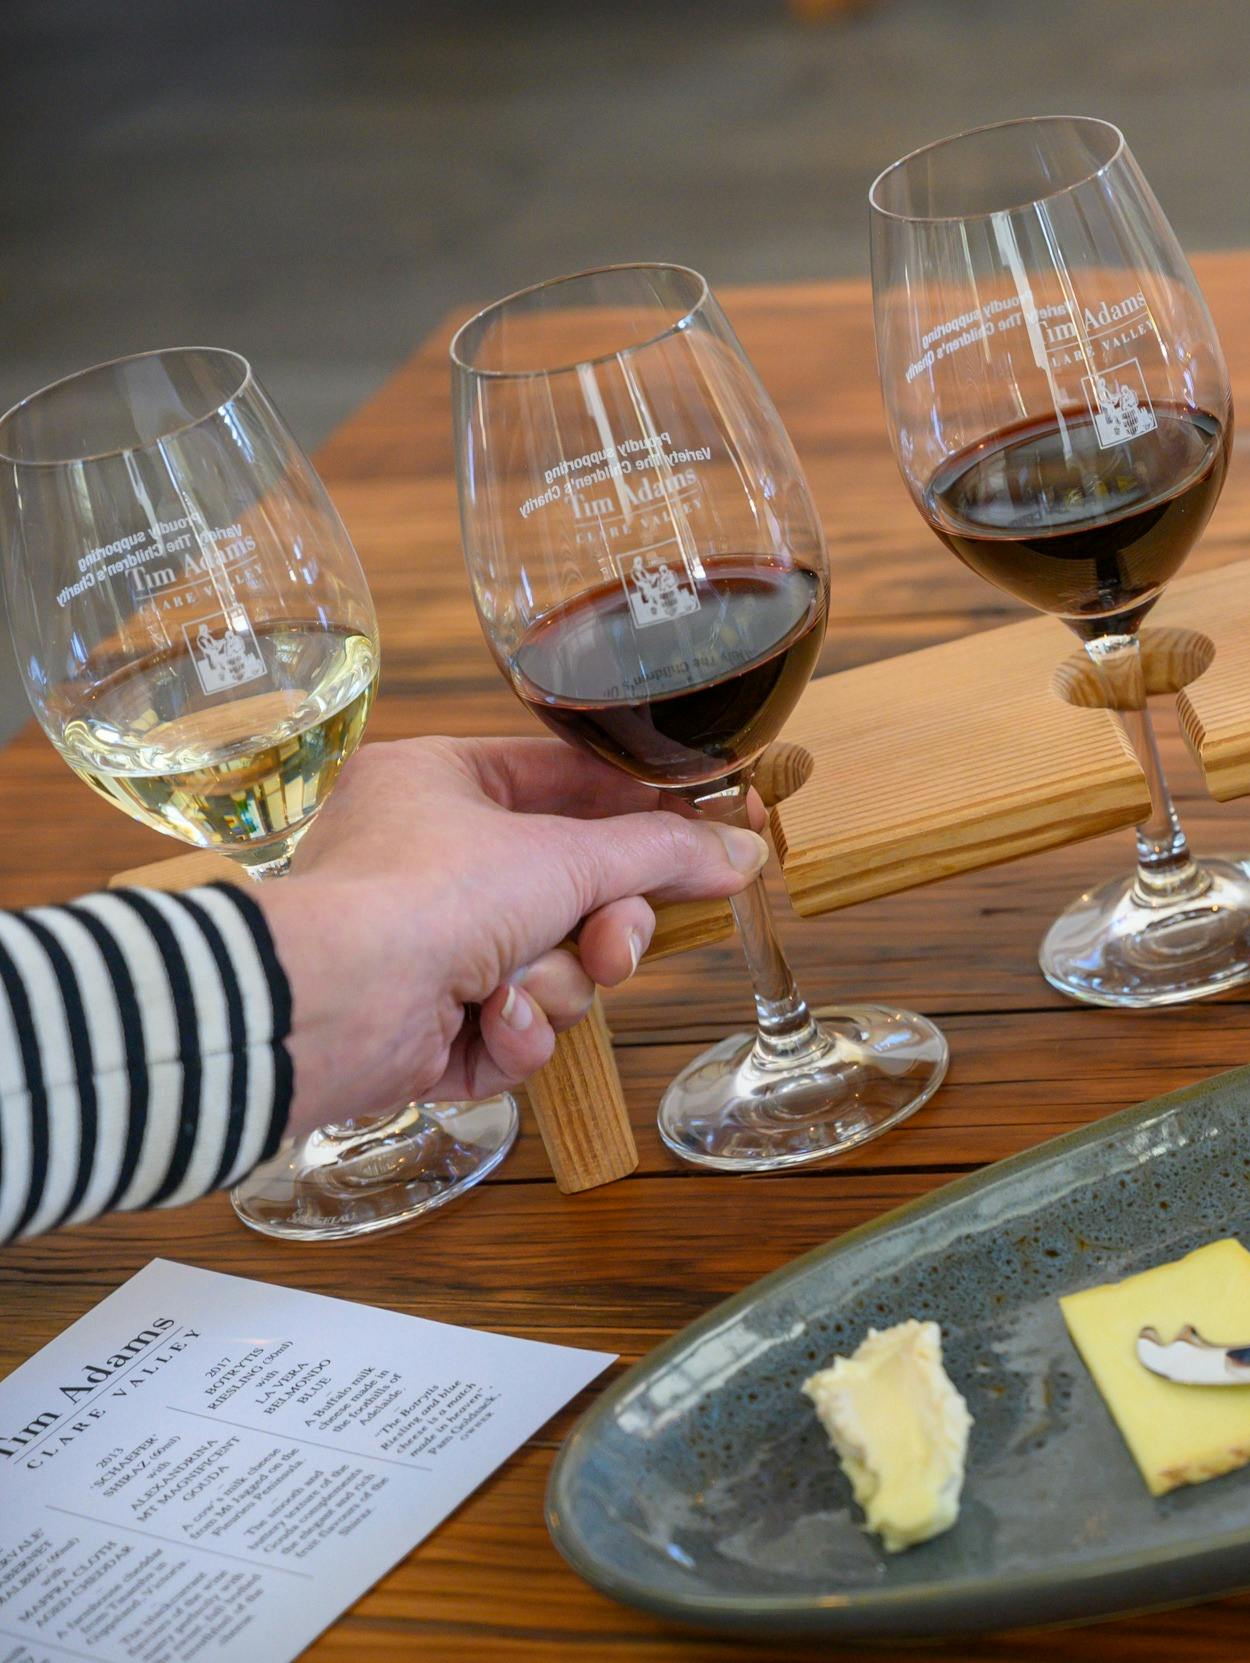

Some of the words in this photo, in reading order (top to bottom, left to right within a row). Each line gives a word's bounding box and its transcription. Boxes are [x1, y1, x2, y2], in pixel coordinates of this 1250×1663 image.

[1083, 292, 1146, 331] Adams
[1051, 347, 1095, 368] LARE
[1102, 319, 1156, 351] VALLEY
[124, 566, 176, 592] Tim
[58, 1317, 174, 1404] Adams
[203, 1355, 232, 1379] 2017
[203, 1346, 265, 1396] BOTRYTIS
[205, 1364, 264, 1411] RIESLING
[261, 1339, 294, 1366] (30ml)
[253, 1389, 277, 1405] LA
[271, 1361, 309, 1388] VERA
[254, 1369, 280, 1388] with
[26, 1408, 106, 1469] CLARE
[111, 1328, 200, 1396] VALLEY
[262, 1357, 332, 1415] BELMONDO
[295, 1375, 332, 1405] BLUE
[94, 1446, 124, 1469] 2013
[101, 1458, 151, 1497] SHIRAZ
[147, 1434, 182, 1461] (60ml)
[129, 1438, 219, 1512] ALEXANDRINA
[135, 1503, 158, 1523] MT
[155, 1434, 241, 1505] MAGNIFICENT
[145, 1460, 172, 1480] with
[181, 1464, 230, 1502] GOUDA
